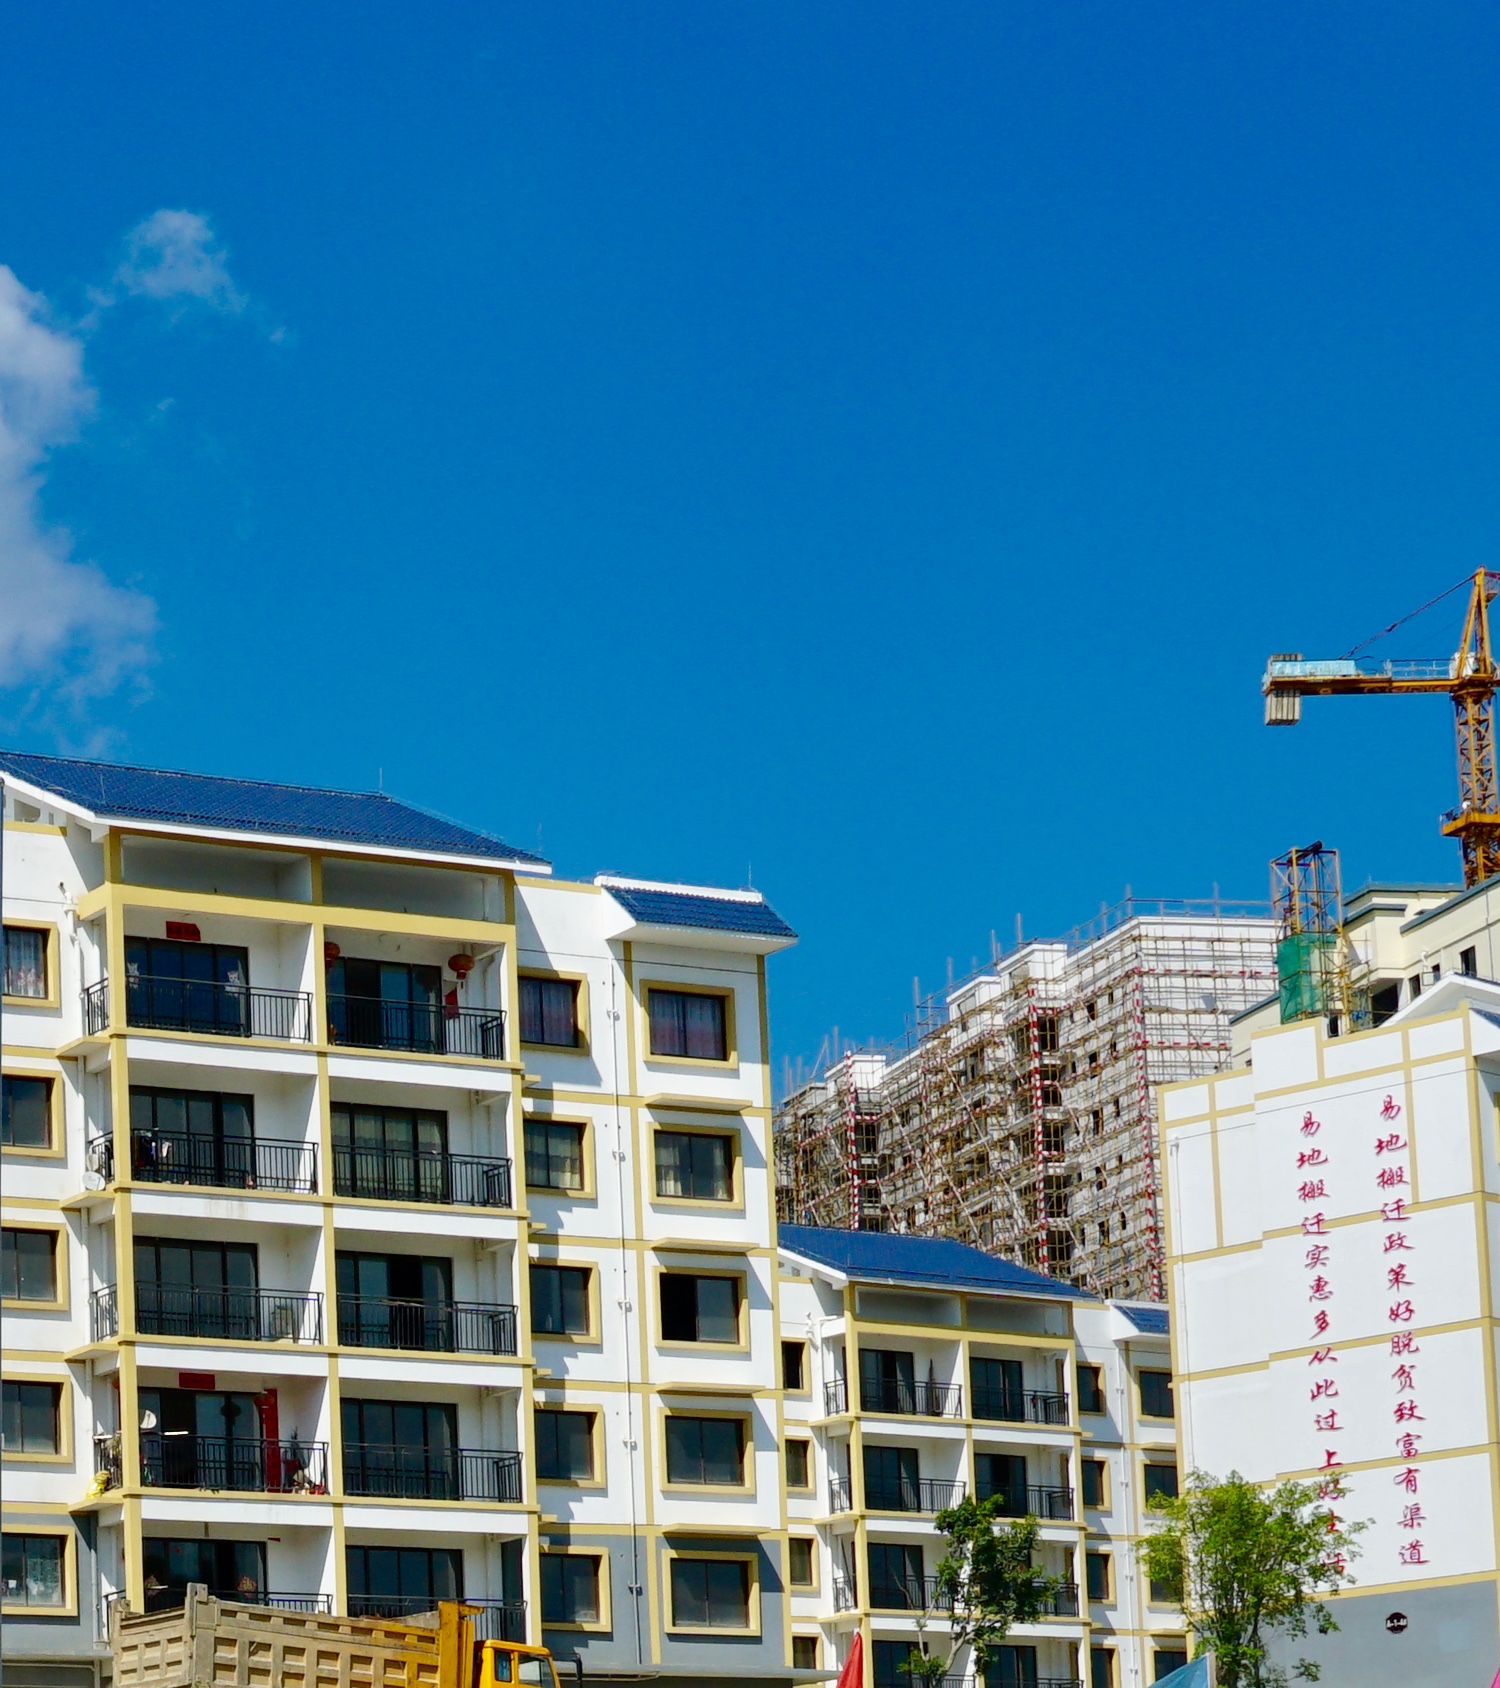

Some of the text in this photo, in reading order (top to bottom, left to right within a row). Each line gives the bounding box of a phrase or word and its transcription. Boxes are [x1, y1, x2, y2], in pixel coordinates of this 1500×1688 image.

[1374, 1094, 1431, 1566] 易地搬迁政策好脱贫致富有渠道
